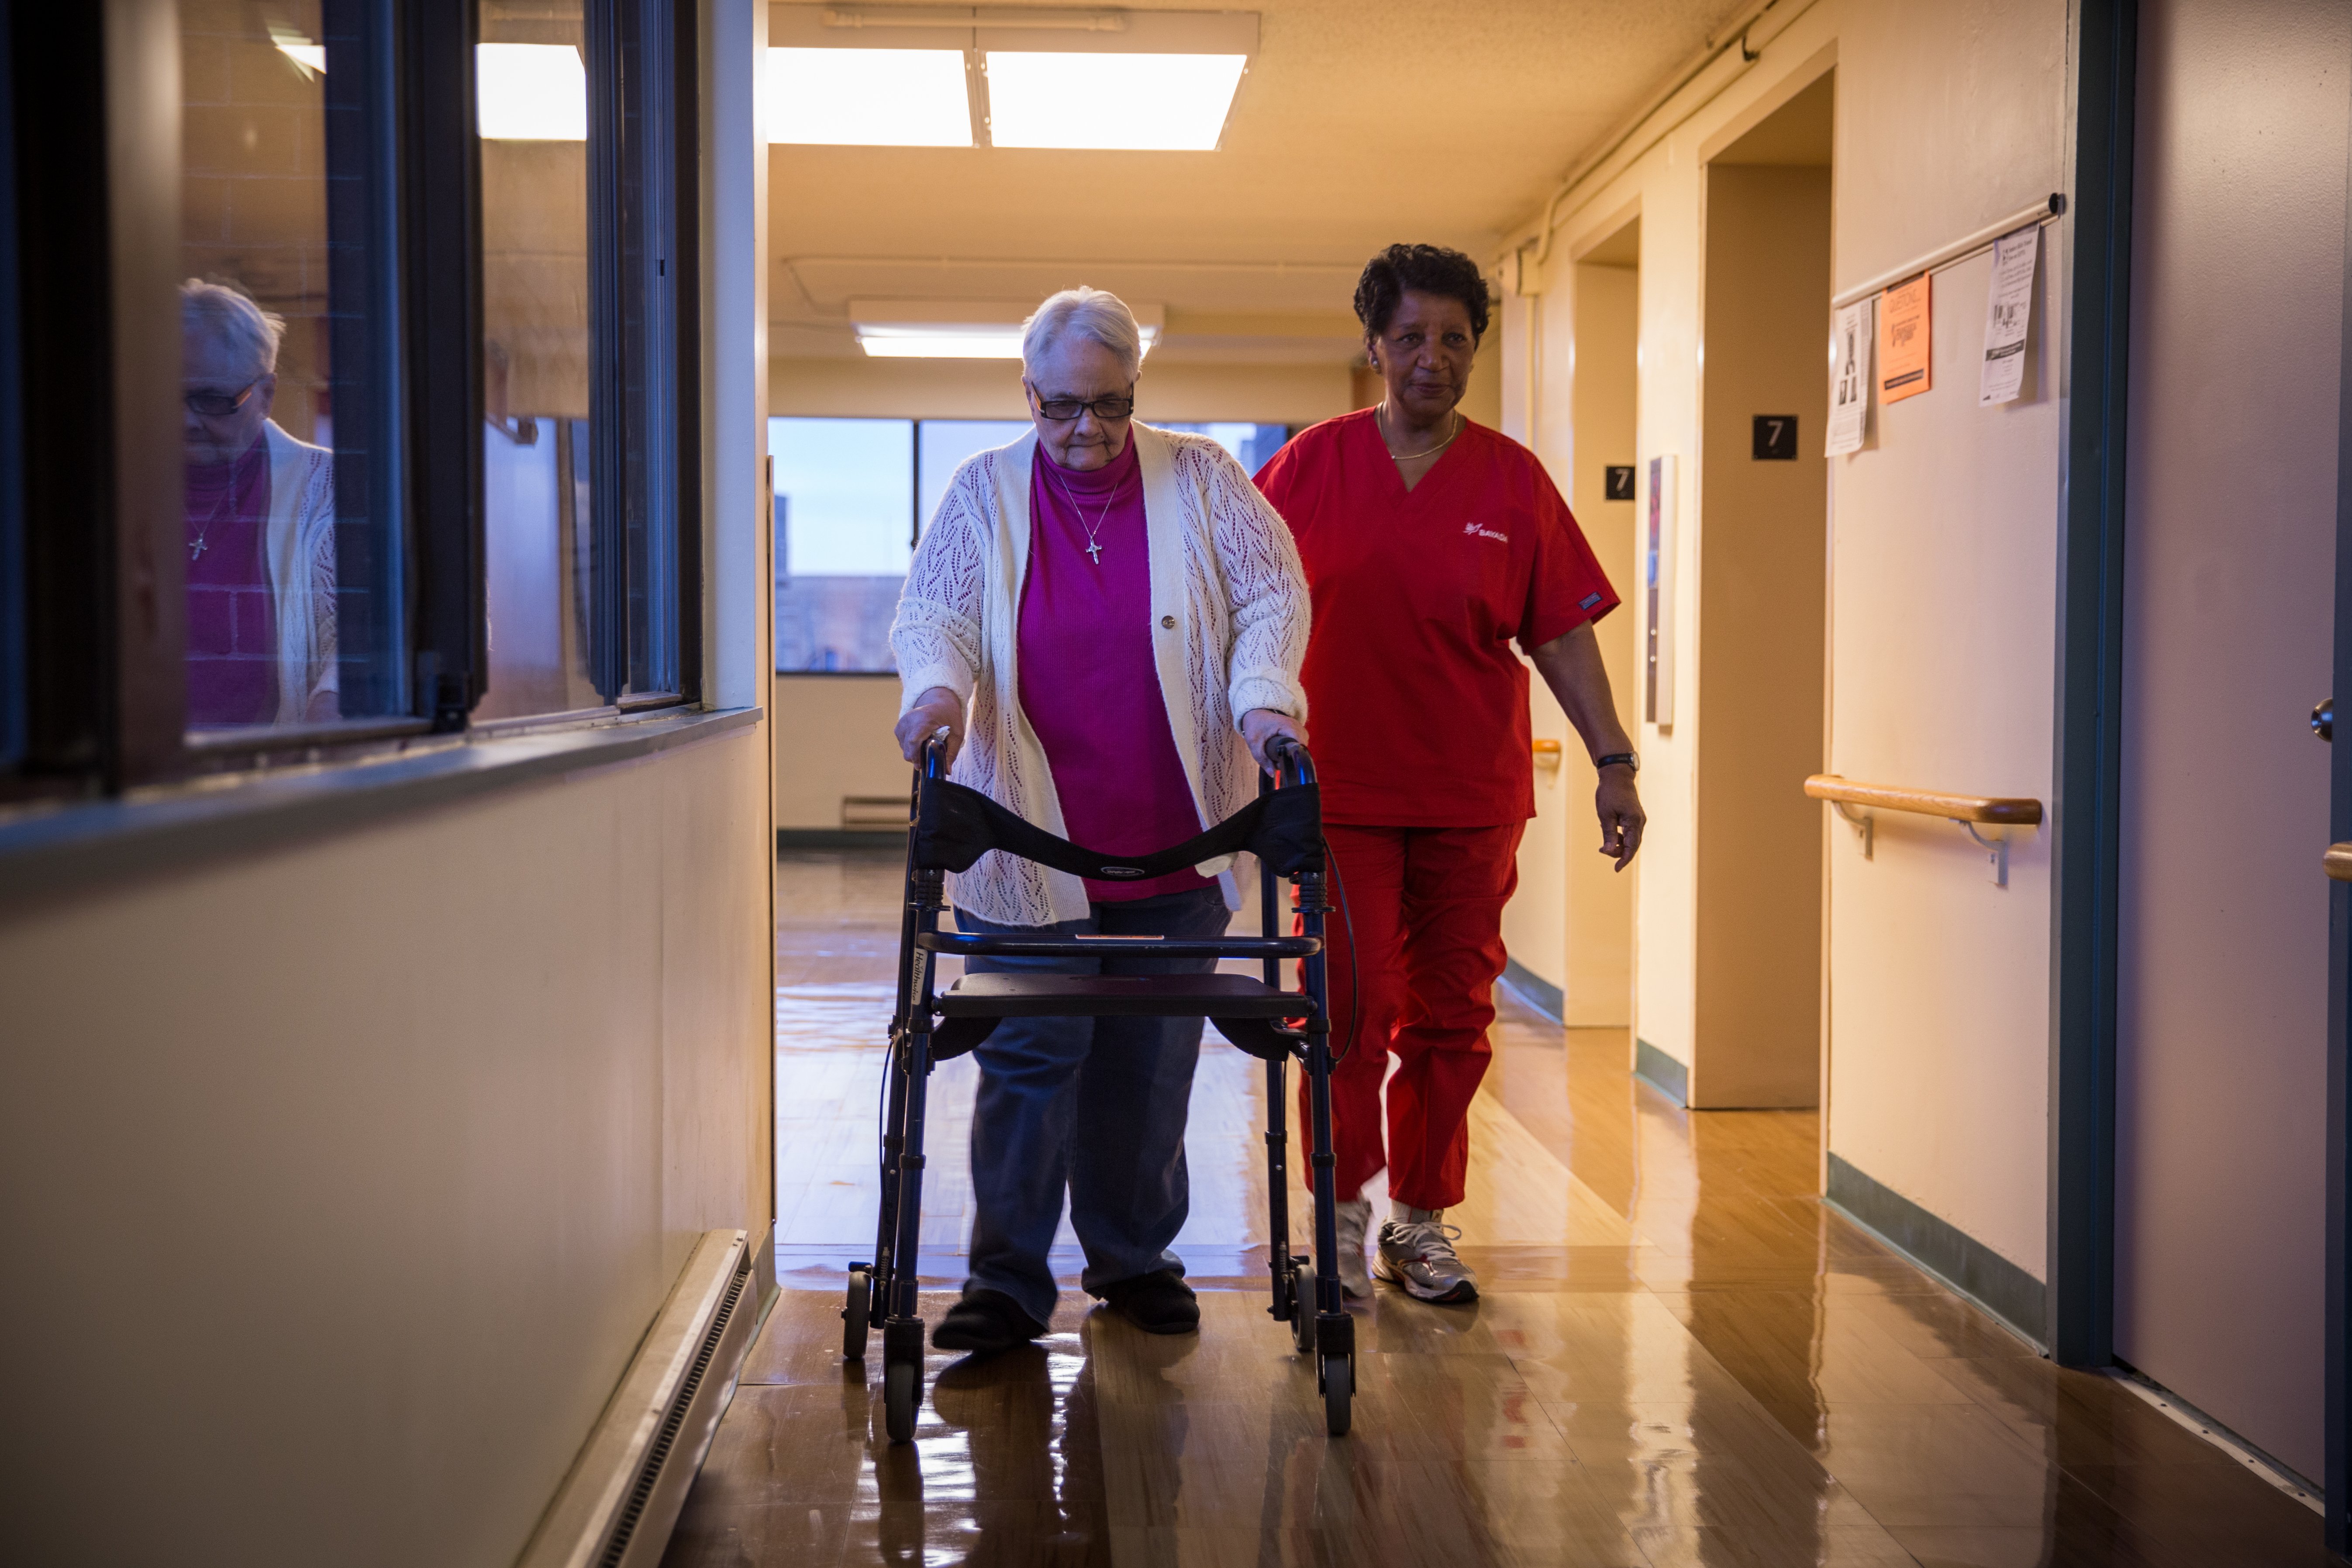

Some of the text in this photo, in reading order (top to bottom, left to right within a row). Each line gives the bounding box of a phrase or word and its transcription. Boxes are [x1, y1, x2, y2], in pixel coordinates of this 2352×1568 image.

[1767, 420, 1783, 446] 7
[1615, 468, 1629, 491] 7
[911, 952, 924, 1001] Healthwise
